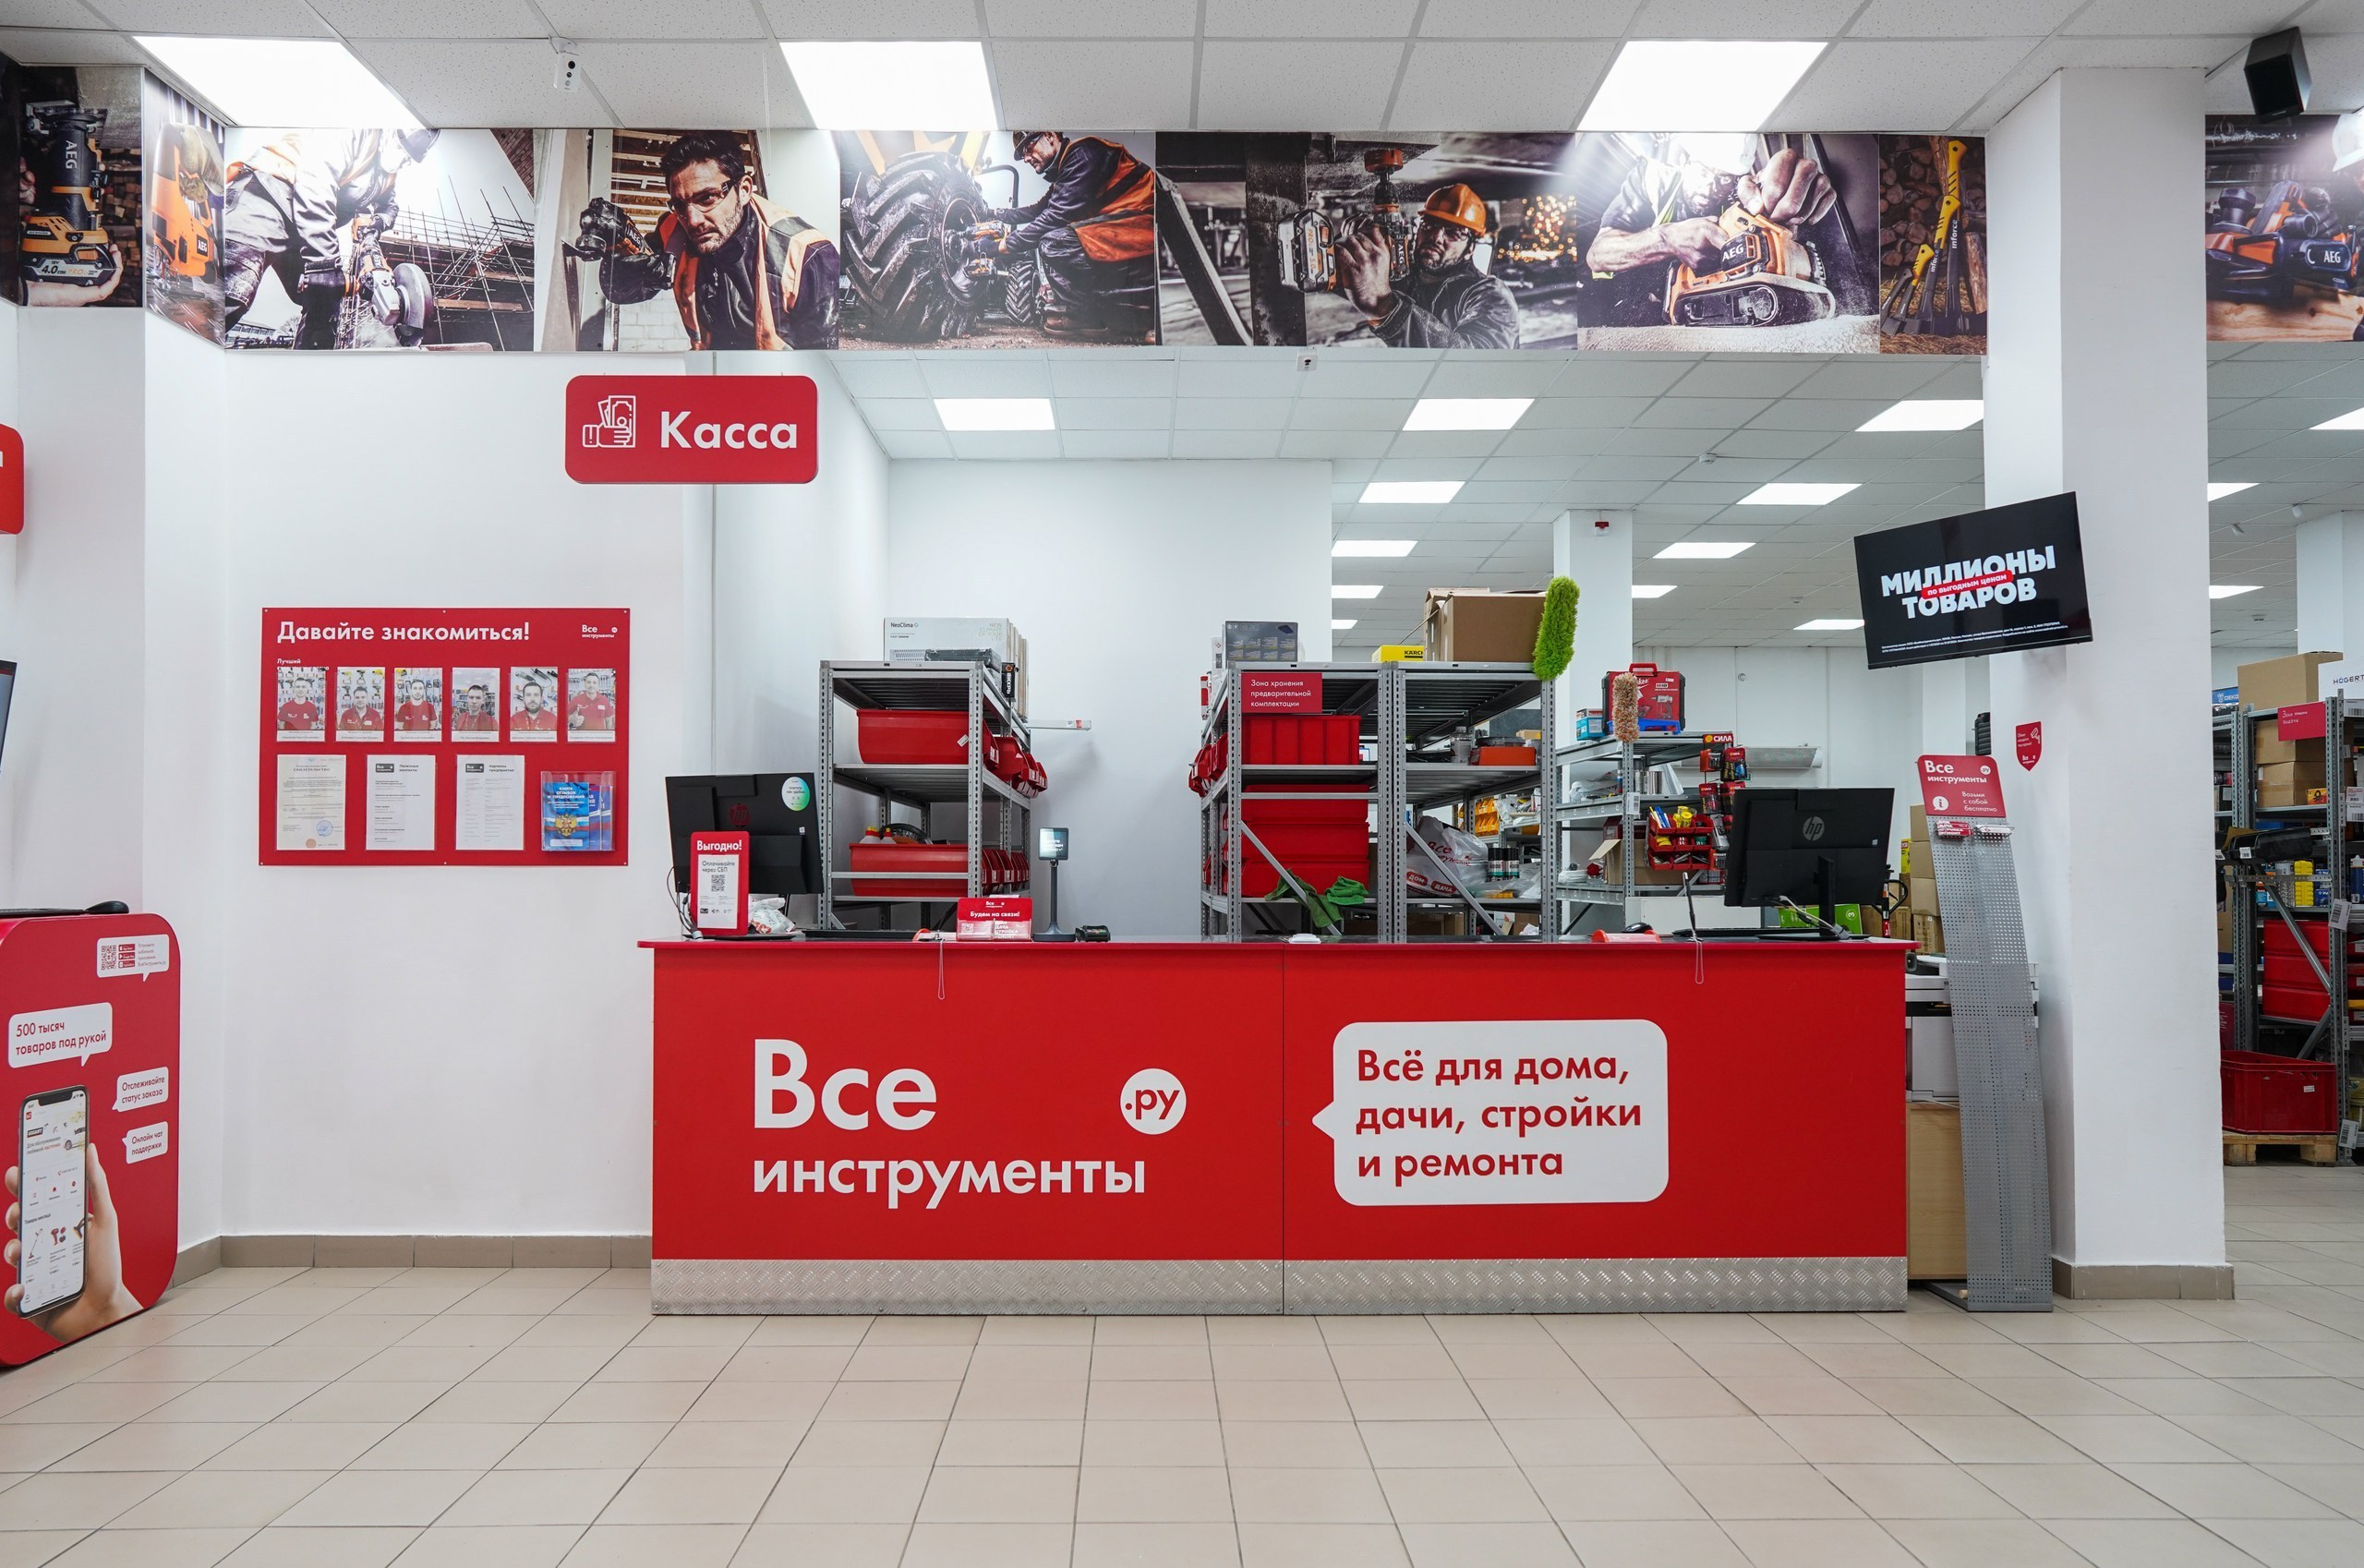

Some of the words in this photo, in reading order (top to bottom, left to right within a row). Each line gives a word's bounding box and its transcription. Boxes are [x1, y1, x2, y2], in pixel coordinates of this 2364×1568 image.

[65, 140, 78, 170] AEG
[198, 238, 208, 252] AEG
[629, 230, 641, 245] AEG
[1722, 244, 1744, 262] AEG
[2323, 250, 2341, 263] AEG
[42, 265, 58, 274] 4.0
[660, 411, 798, 450] Касса
[1880, 545, 2056, 597] МИЛЛИОНЫ
[1939, 579, 1980, 594] выгодным
[1980, 573, 2008, 586] ценам
[1901, 577, 2037, 620] ТОВАРОВ
[277, 621, 375, 644] Давайте
[381, 621, 530, 641] знакомиться!
[581, 624, 598, 633] Все
[1270, 681, 1304, 689] хранения
[1250, 690, 1311, 699] предварительной
[1924, 760, 1955, 774] Все
[1927, 776, 1987, 784] инструменты
[1803, 816, 1825, 841] hp
[696, 839, 742, 852] Выгодно!
[1407, 874, 1426, 885] ДОМ
[16, 1022, 36, 1038] 500
[38, 1021, 65, 1034] тысяч
[16, 1040, 56, 1055] товаров
[58, 1037, 77, 1050] под
[78, 1030, 107, 1049] рукой
[1358, 1049, 1424, 1081] Всё
[1435, 1058, 1502, 1086] для
[1514, 1056, 1629, 1085] дома,
[122, 1075, 165, 1092] Отслеживайте
[754, 1038, 937, 1131] Все
[1125, 1089, 1180, 1120] .ру
[121, 1092, 141, 1104] статус
[141, 1088, 163, 1101] заказа
[1356, 1107, 1465, 1135] дачи,
[1481, 1096, 1641, 1138] стройки
[131, 1133, 154, 1144] Онлайн
[154, 1130, 163, 1139] чат
[131, 1141, 163, 1156] поддержки
[1358, 1156, 1381, 1176] и
[1394, 1153, 1562, 1187] ремонта
[754, 1159, 1145, 1210] инструменты
